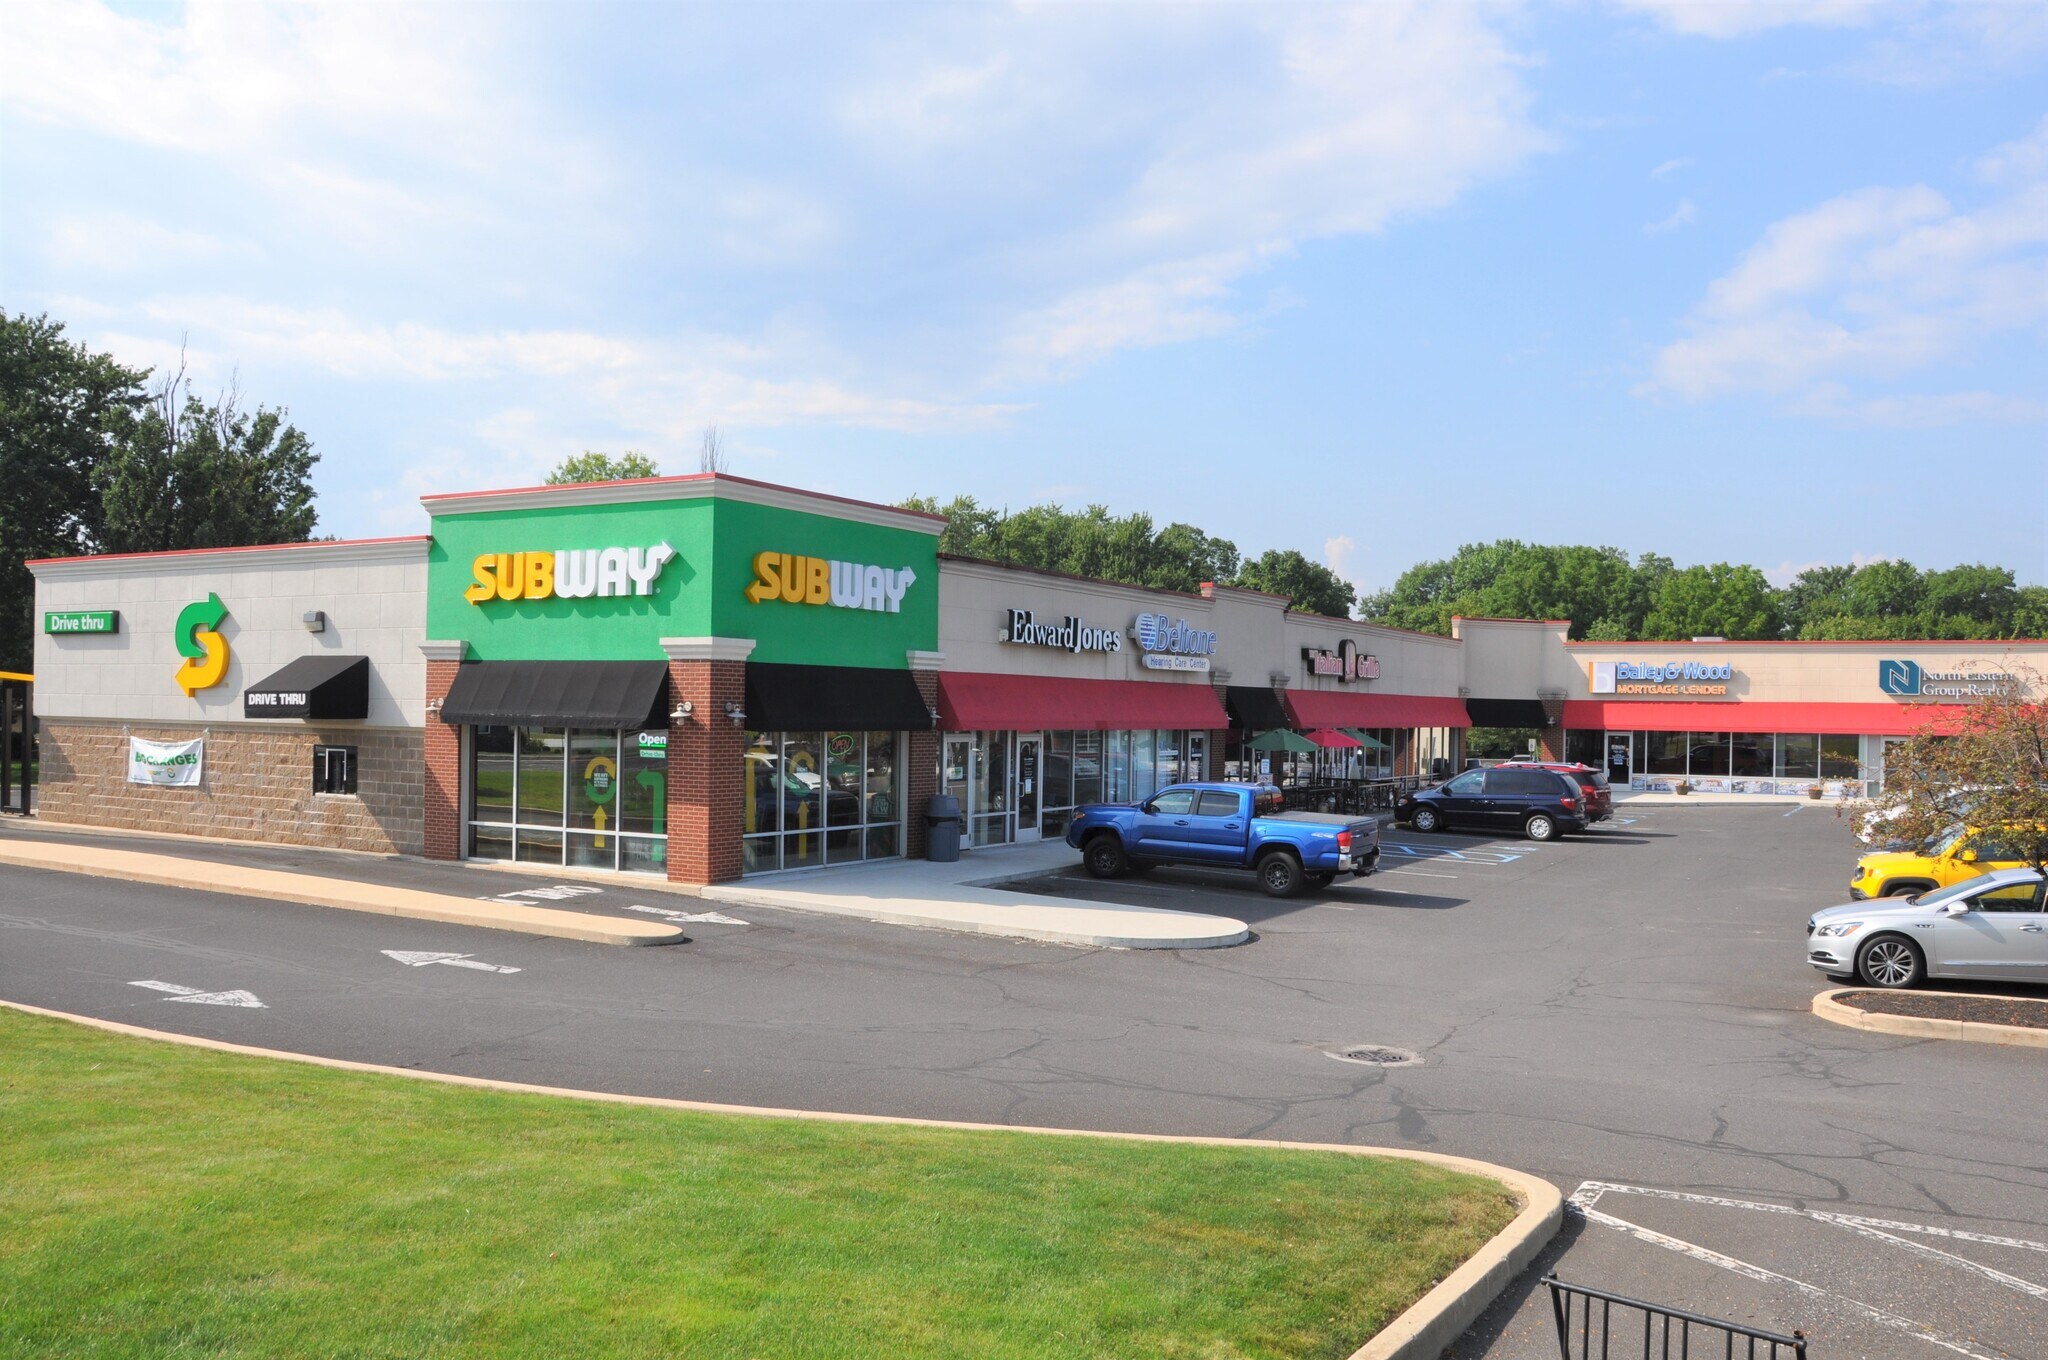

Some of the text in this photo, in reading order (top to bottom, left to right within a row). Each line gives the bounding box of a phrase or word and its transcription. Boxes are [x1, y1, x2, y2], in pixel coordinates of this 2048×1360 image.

[464, 540, 677, 606] SUBWAY
[745, 551, 917, 613] SUBWAY
[51, 614, 104, 631] Drive thru
[1006, 608, 1121, 654] Edward Jones
[1155, 614, 1217, 655] Beltone
[1150, 655, 1207, 669] Hearing Care Center
[1314, 651, 1344, 676] Italian
[1617, 661, 1731, 683] Bailey & Wood
[1922, 669, 1961, 681] North
[1617, 684, 1727, 695] MORTGAGE LENDER
[1922, 684, 1964, 699] Group
[248, 693, 306, 705] DRIVE THRU
[639, 732, 667, 747] Open
